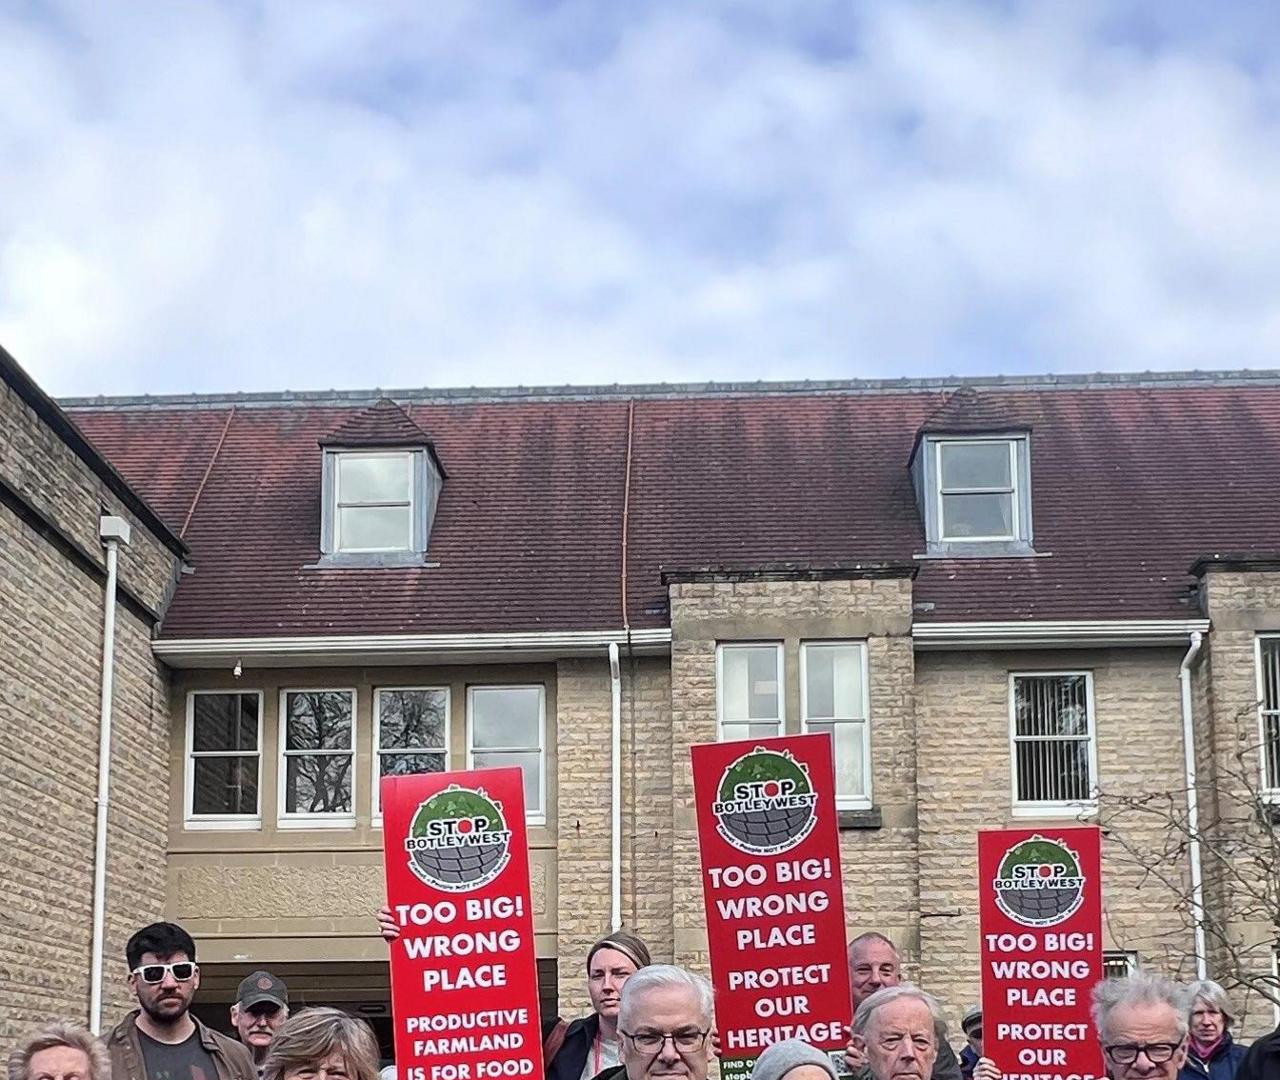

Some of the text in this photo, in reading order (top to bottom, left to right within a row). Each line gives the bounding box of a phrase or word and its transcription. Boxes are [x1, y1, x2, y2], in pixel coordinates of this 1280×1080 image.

[709, 858, 832, 888] TOO BIG!
[396, 897, 523, 926] TOO BIG!
[717, 891, 828, 920] WRONG
[404, 930, 520, 959] WRONG
[737, 925, 815, 950] PLACE
[985, 933, 1093, 952] TOO BIG!
[423, 965, 506, 992] PLACE
[992, 961, 1090, 979] WRONG
[1007, 989, 1076, 1006] PLACE
[407, 1009, 528, 1032] PRODUCTIVE
[414, 1034, 523, 1056] FARMLAND
[477, 1058, 533, 1077] FOOD
